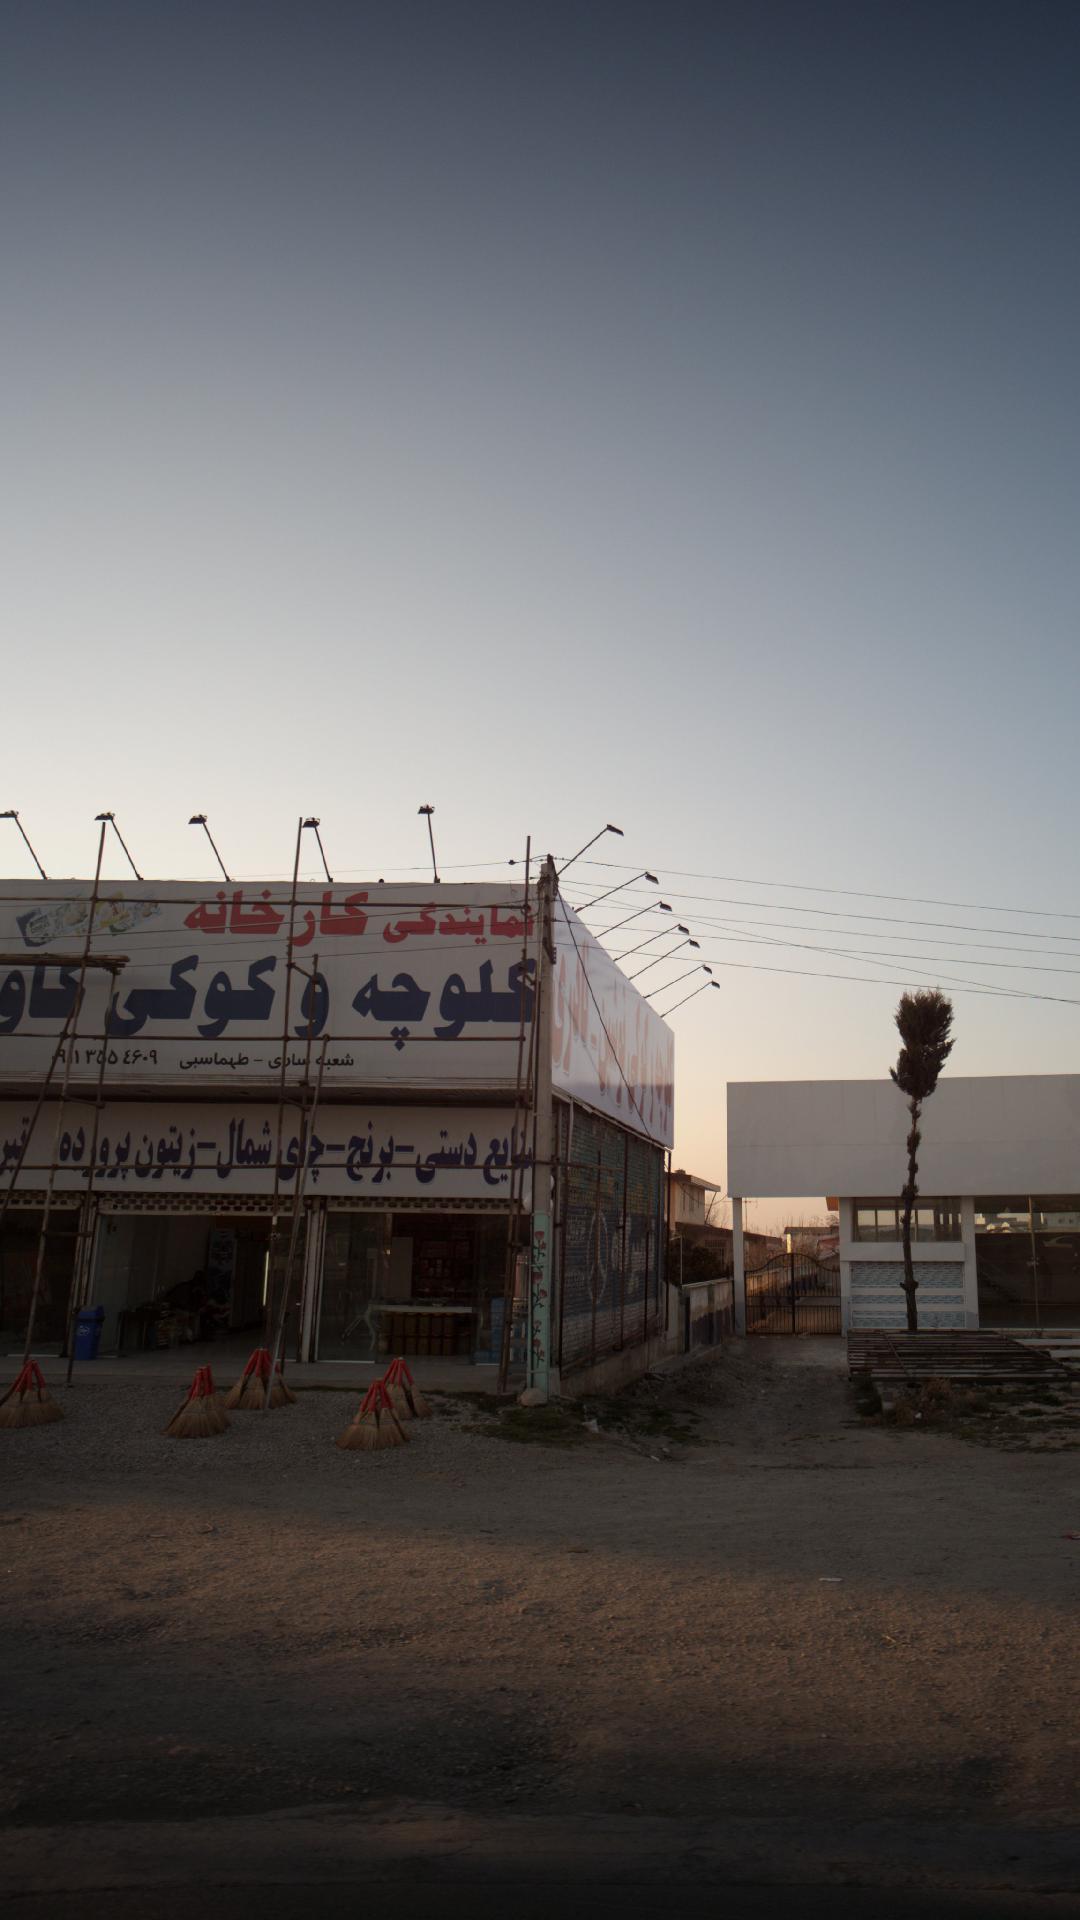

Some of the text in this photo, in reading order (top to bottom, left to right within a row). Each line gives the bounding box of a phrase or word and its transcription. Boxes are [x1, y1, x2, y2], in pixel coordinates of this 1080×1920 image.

[382, 902, 534, 944] نمایندگی
[105, 955, 276, 1038] کوکی
[294, 972, 329, 1038] و
[179, 1052, 249, 1070] طهماسبی
[268, 1053, 310, 1069] ساری
[316, 1053, 354, 1070] شعبه
[134, 1126, 195, 1180] زیتون
[217, 1117, 272, 1179] شمال
[347, 1120, 394, 1183] برنج
[415, 1129, 477, 1183] دستی
